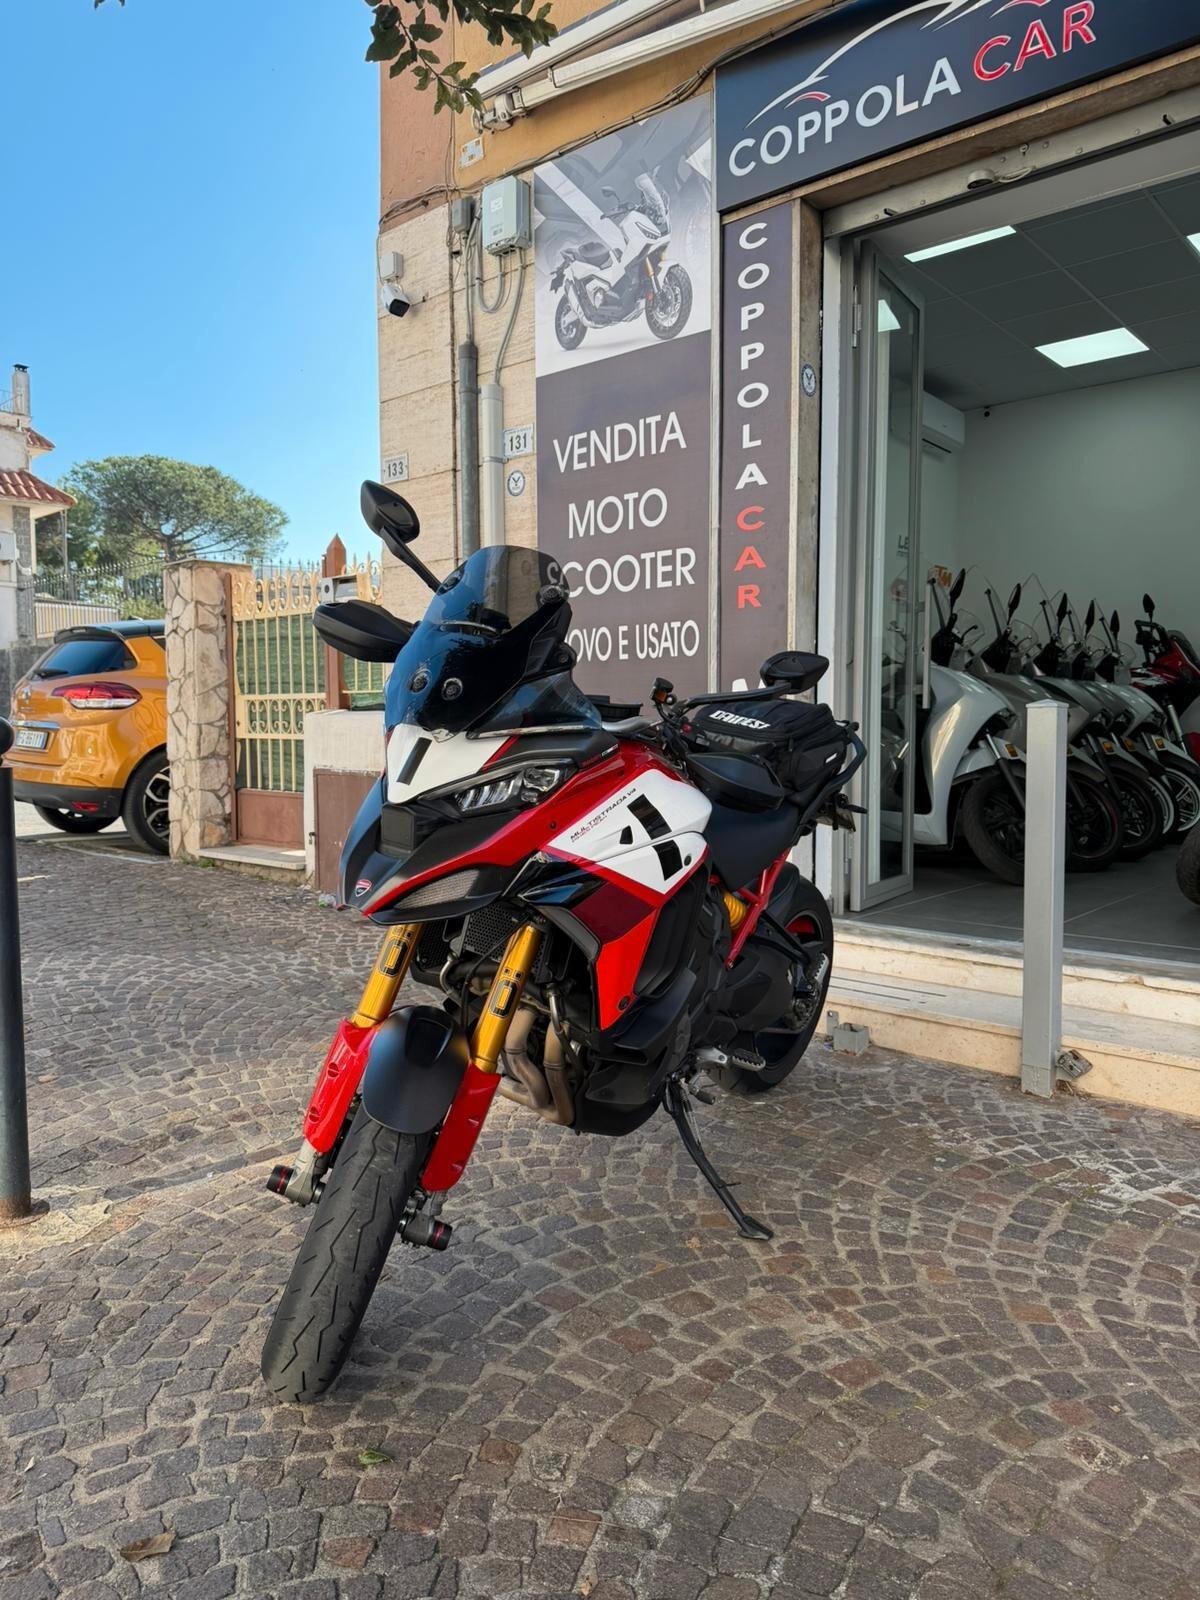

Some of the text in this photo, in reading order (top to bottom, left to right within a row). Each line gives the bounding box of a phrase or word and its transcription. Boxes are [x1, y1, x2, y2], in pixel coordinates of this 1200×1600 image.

[728, 0, 1096, 177] COPPOLA CAR
[509, 432, 527, 451] 131
[734, 222, 770, 609] COPPOLA CAR
[553, 411, 687, 473] VENDITA
[387, 461, 404, 478] 133
[568, 487, 668, 539] MOTO
[564, 619, 700, 663] OVO E USATO
